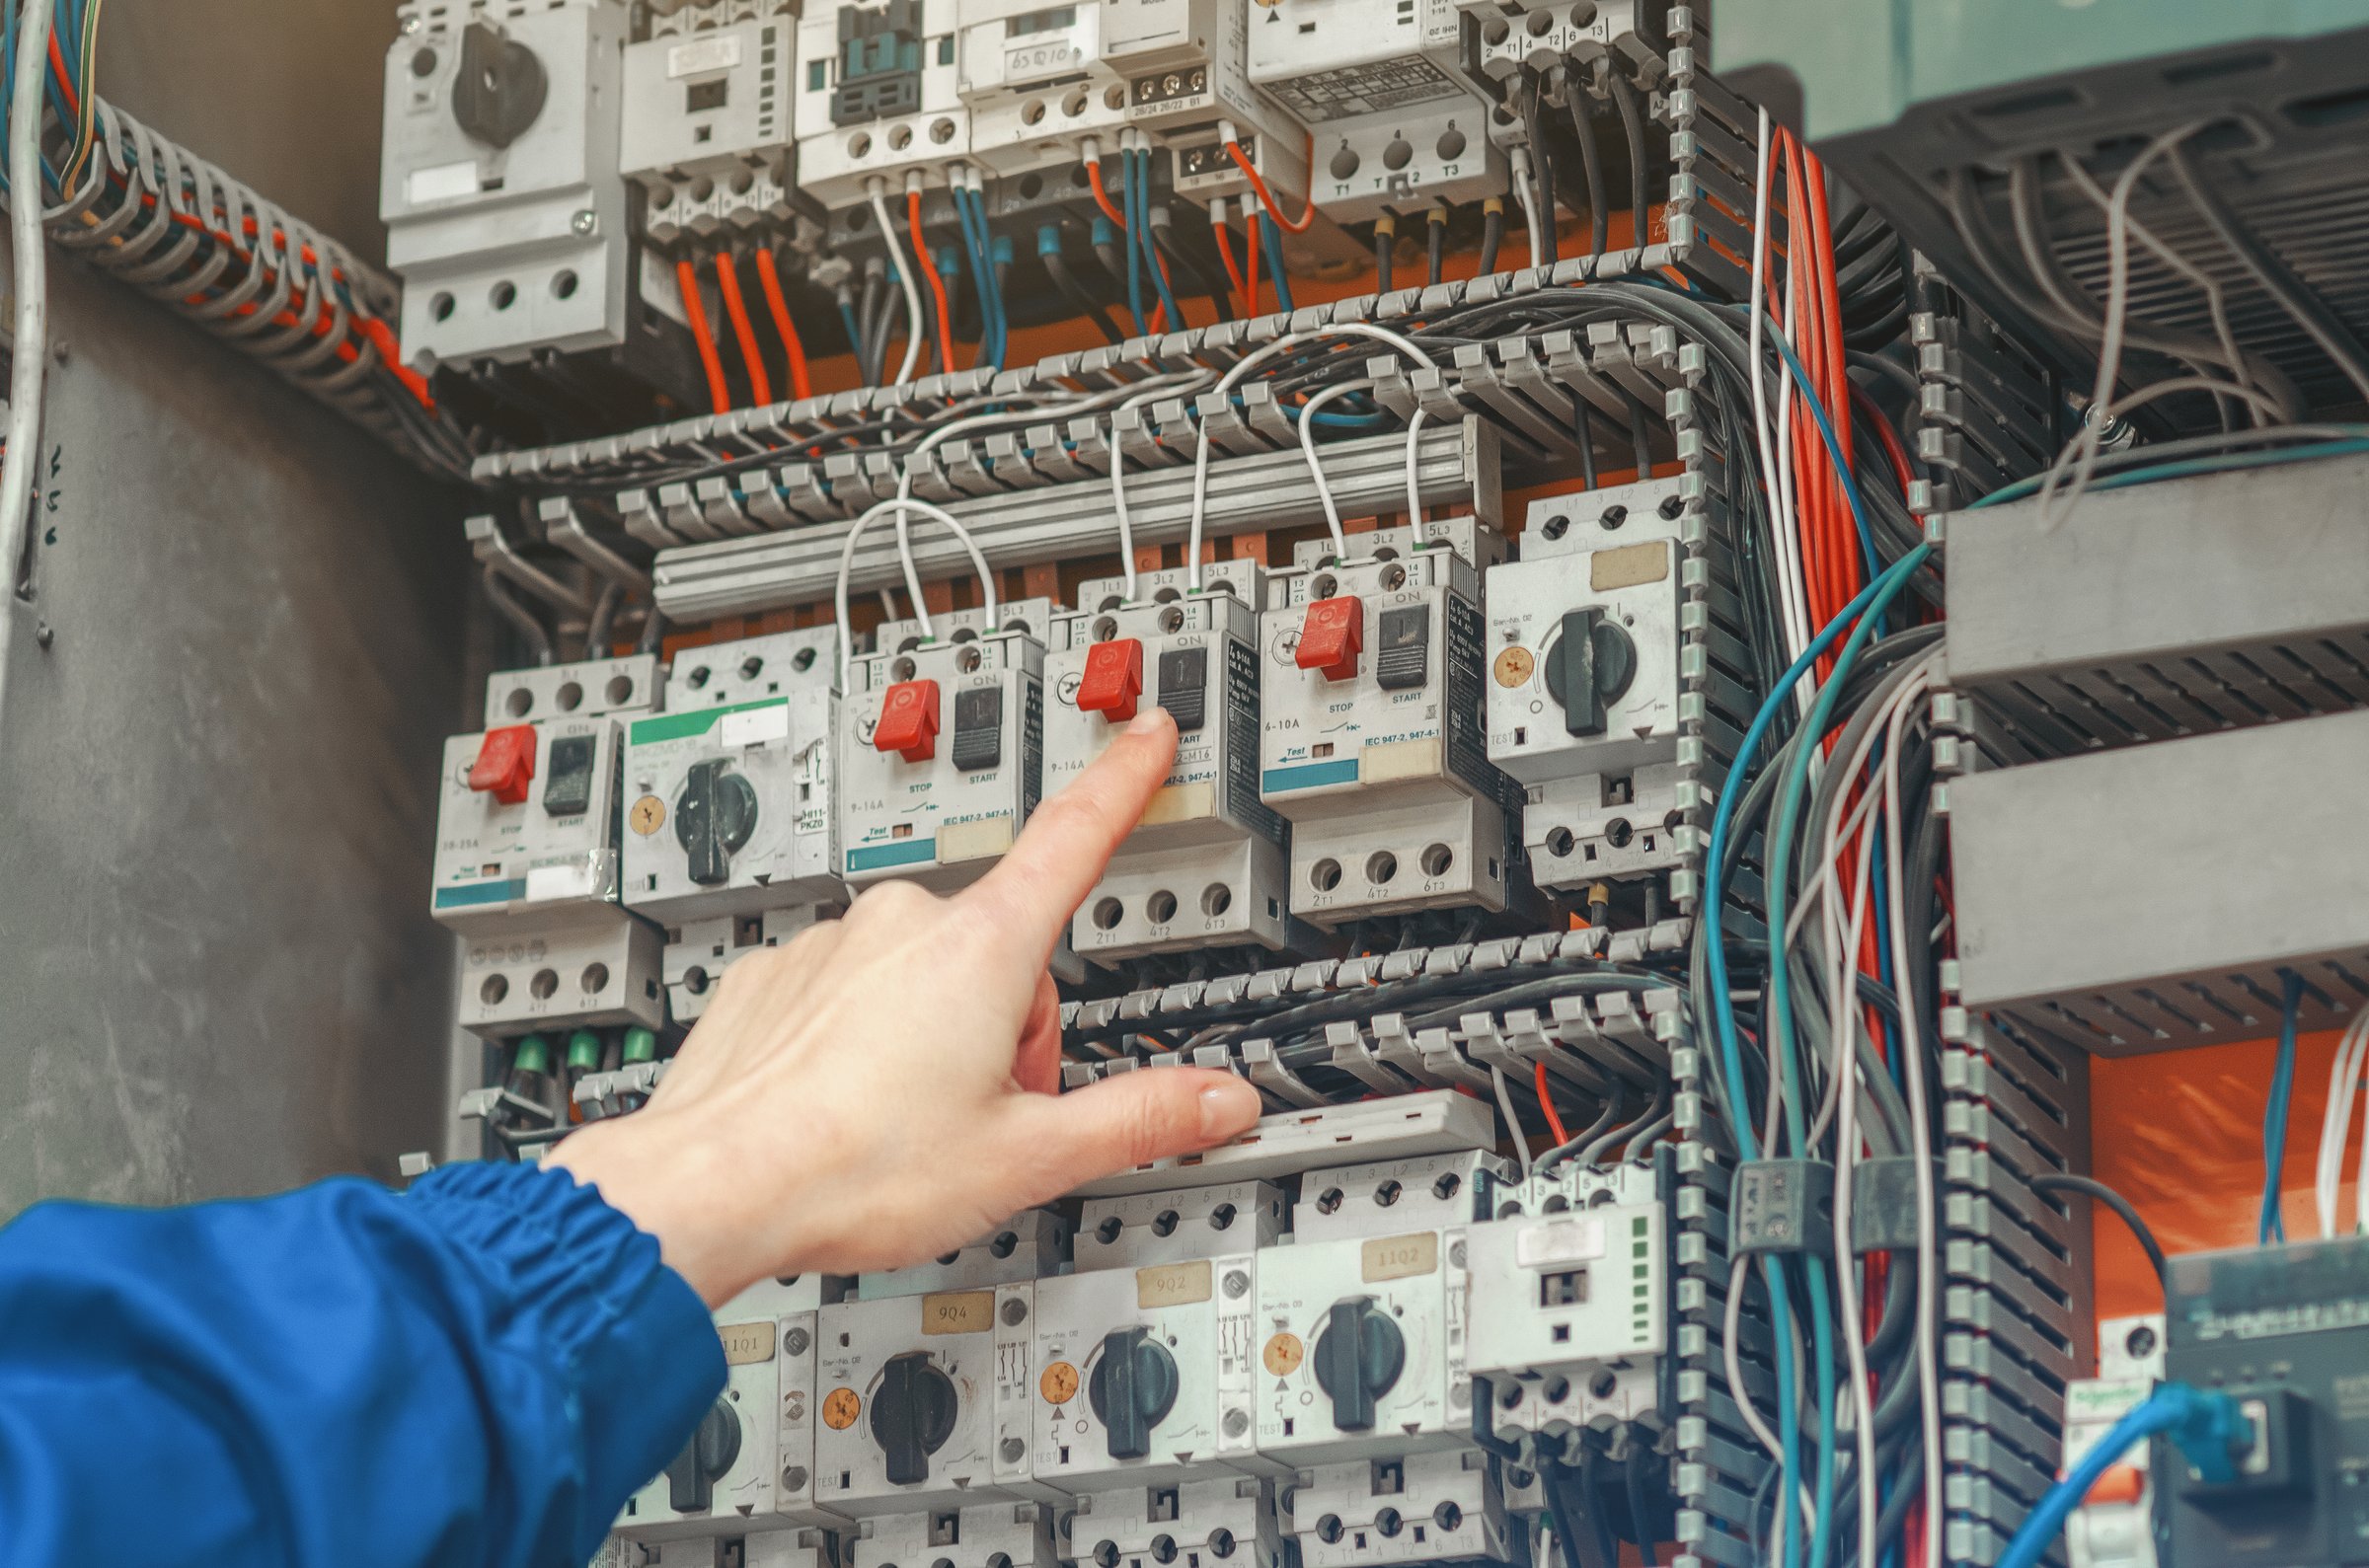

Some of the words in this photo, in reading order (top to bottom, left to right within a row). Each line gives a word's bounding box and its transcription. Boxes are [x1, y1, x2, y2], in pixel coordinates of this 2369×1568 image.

[1548, 35, 1560, 45] T2
[1568, 31, 1576, 41] 6
[1591, 26, 1603, 37] T3
[1335, 184, 1350, 195] T1
[1442, 164, 1459, 177] T3
[1373, 533, 1394, 545] 3L2
[1428, 524, 1451, 537] 5L3
[1408, 563, 1418, 572] 14
[1154, 573, 1175, 585] 3L2
[1208, 565, 1230, 577] 5L3
[1293, 579, 1304, 588] 13
[1395, 591, 1421, 604] ON
[951, 614, 970, 626] 3L2
[1003, 604, 1025, 616] 5L3
[1186, 607, 1196, 616] 14
[1075, 622, 1086, 631] 13
[1177, 635, 1202, 647] ON
[972, 674, 998, 687] ON
[1392, 692, 1422, 705] START
[1329, 703, 1354, 714] STOP
[1264, 718, 1300, 732] 6-10A
[1178, 734, 1201, 745] TART
[1365, 737, 1380, 747] IEC
[1410, 728, 1439, 740] 947-4-1
[1491, 730, 1514, 746] TEST
[1177, 749, 1210, 764] 2-M16
[1287, 746, 1306, 757] Test
[1051, 758, 1085, 773] 9-14A
[969, 773, 998, 784] START
[1187, 770, 1217, 783] 947-4-1
[909, 783, 933, 794] STOP
[851, 798, 884, 813] 9-14A
[558, 817, 584, 829] START
[944, 816, 957, 827] IEC
[985, 807, 1015, 820] 947-4-1
[500, 825, 522, 836] STOP
[801, 820, 823, 832] PKZ0
[869, 826, 887, 837] Test
[1312, 894, 1333, 907] 2T1
[1367, 887, 1389, 899] 4T2
[1423, 879, 1445, 892] 6T3
[1096, 932, 1116, 944] 2T1
[1149, 926, 1172, 937] 4T2
[1204, 918, 1226, 931] 6T3
[1378, 1247, 1419, 1268] 11Q2
[1156, 1276, 1185, 1292] 9Q2
[939, 1306, 967, 1321] 9Q4
[1259, 1424, 1281, 1437] TEST
